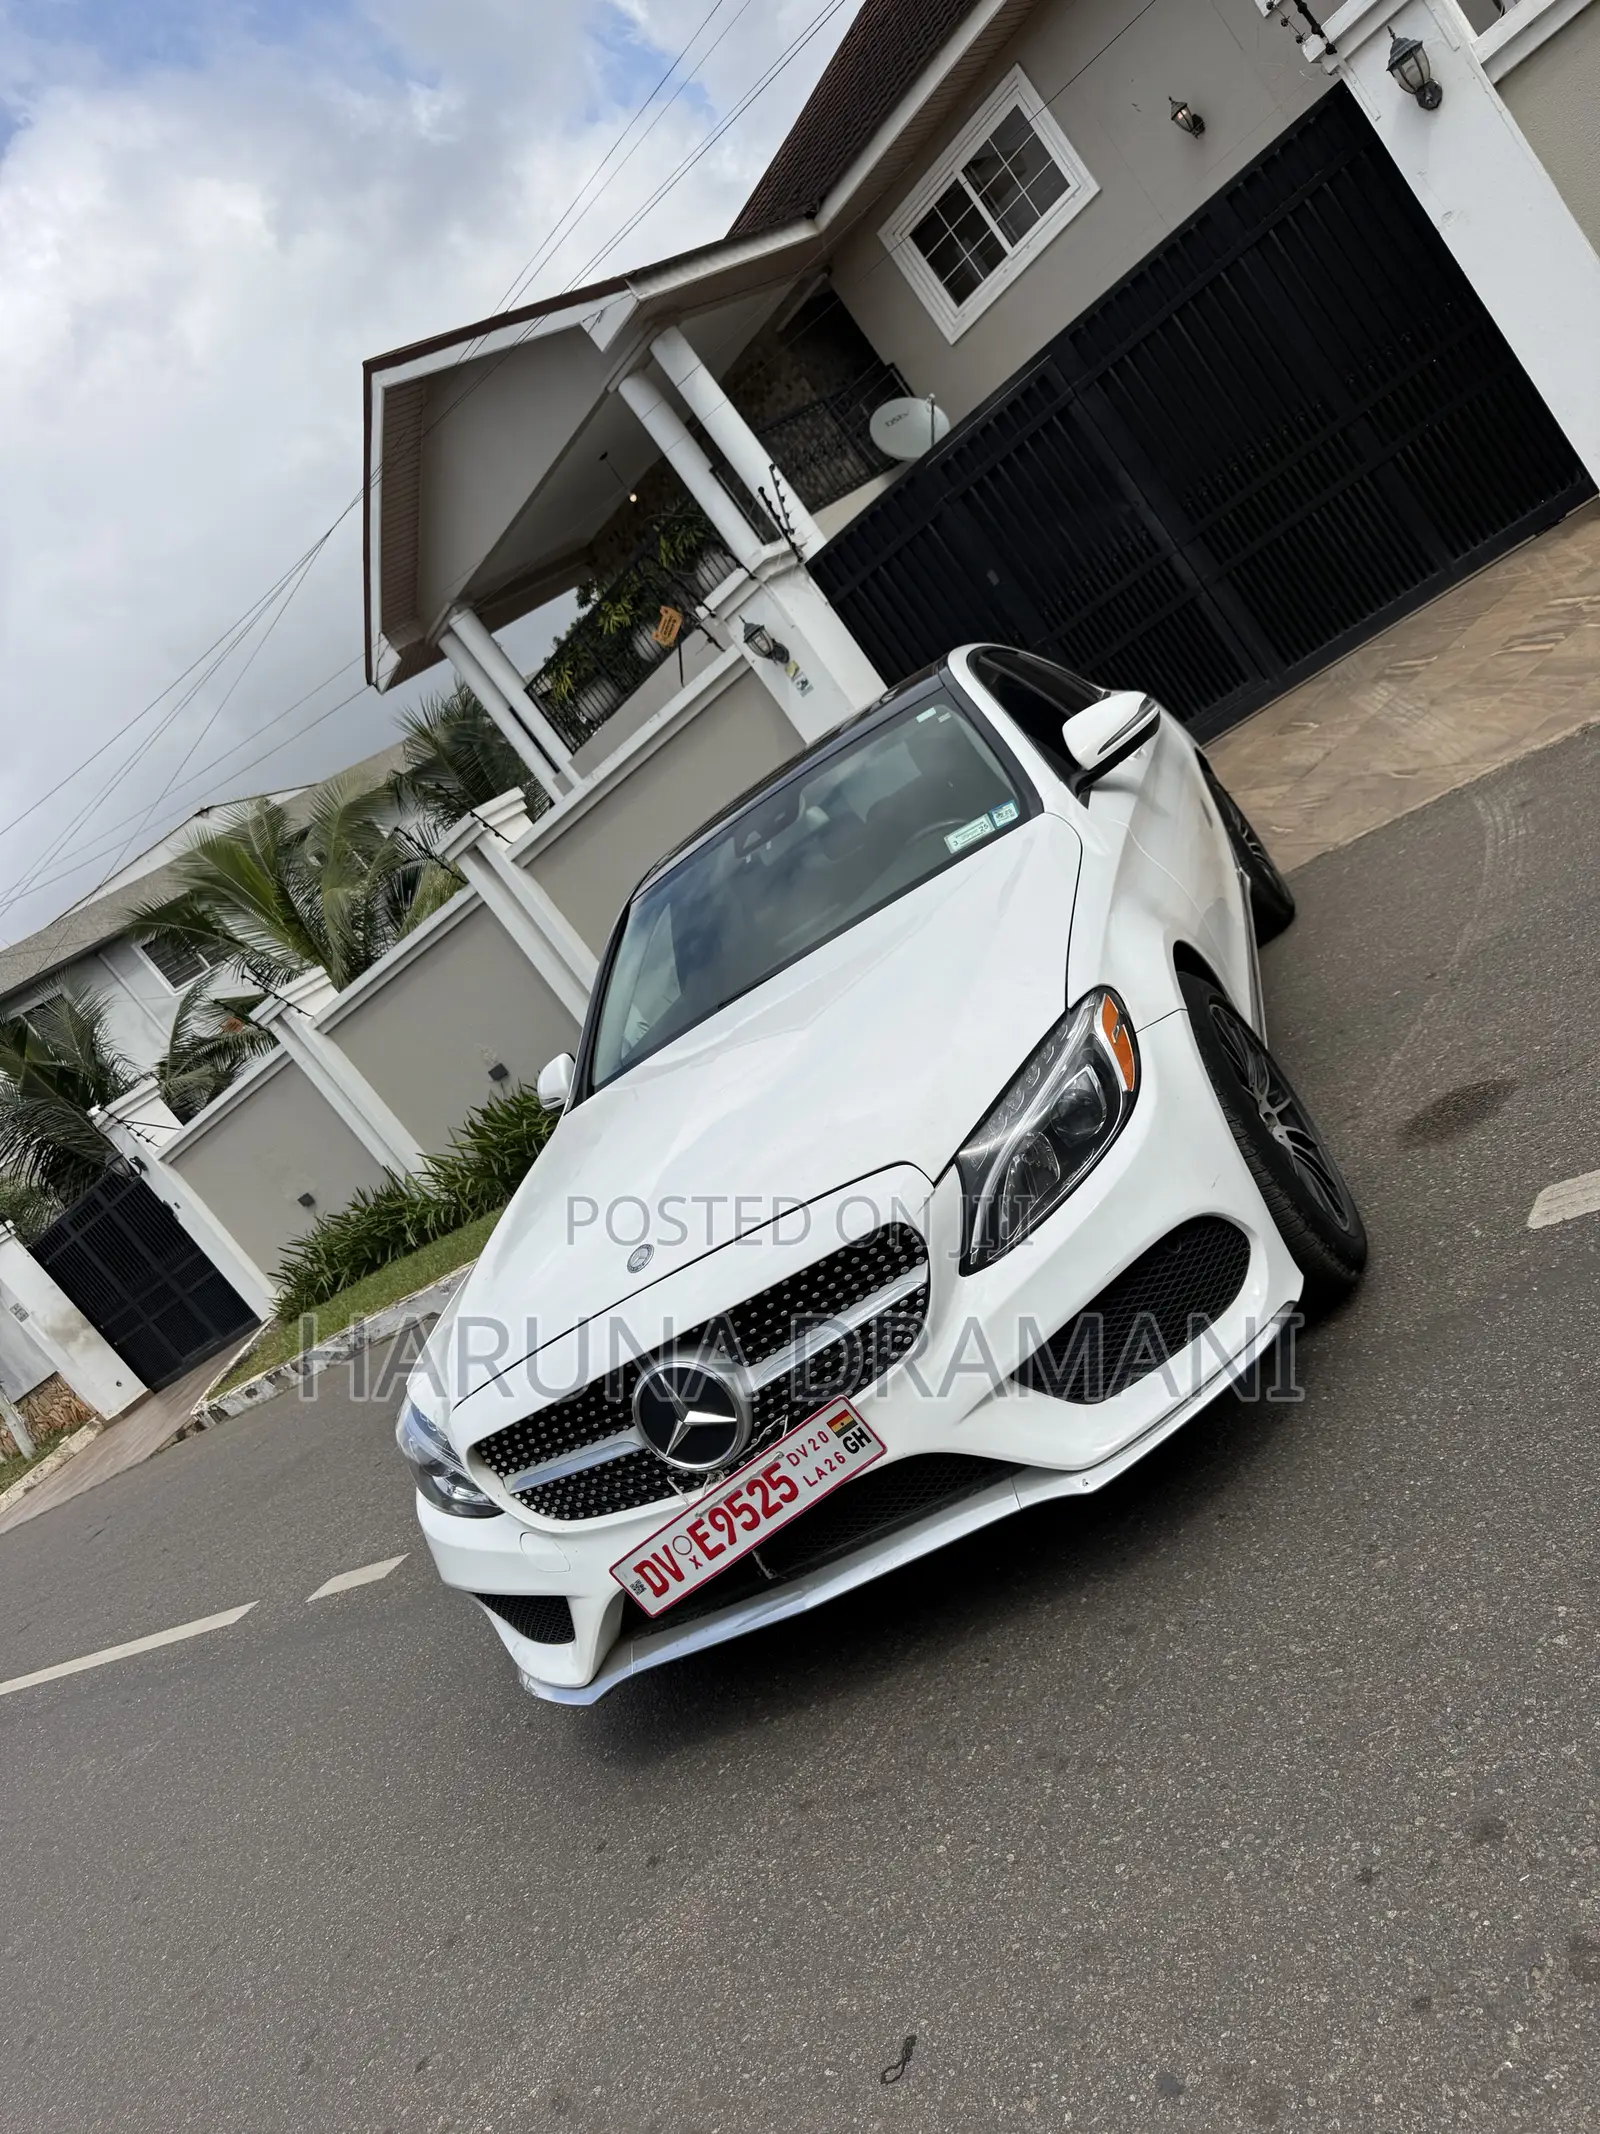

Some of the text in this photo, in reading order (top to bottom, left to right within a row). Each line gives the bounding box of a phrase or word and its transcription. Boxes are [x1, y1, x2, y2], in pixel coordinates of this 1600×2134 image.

[842, 1427, 872, 1455] GH
[633, 1461, 799, 1598] DV E9525
